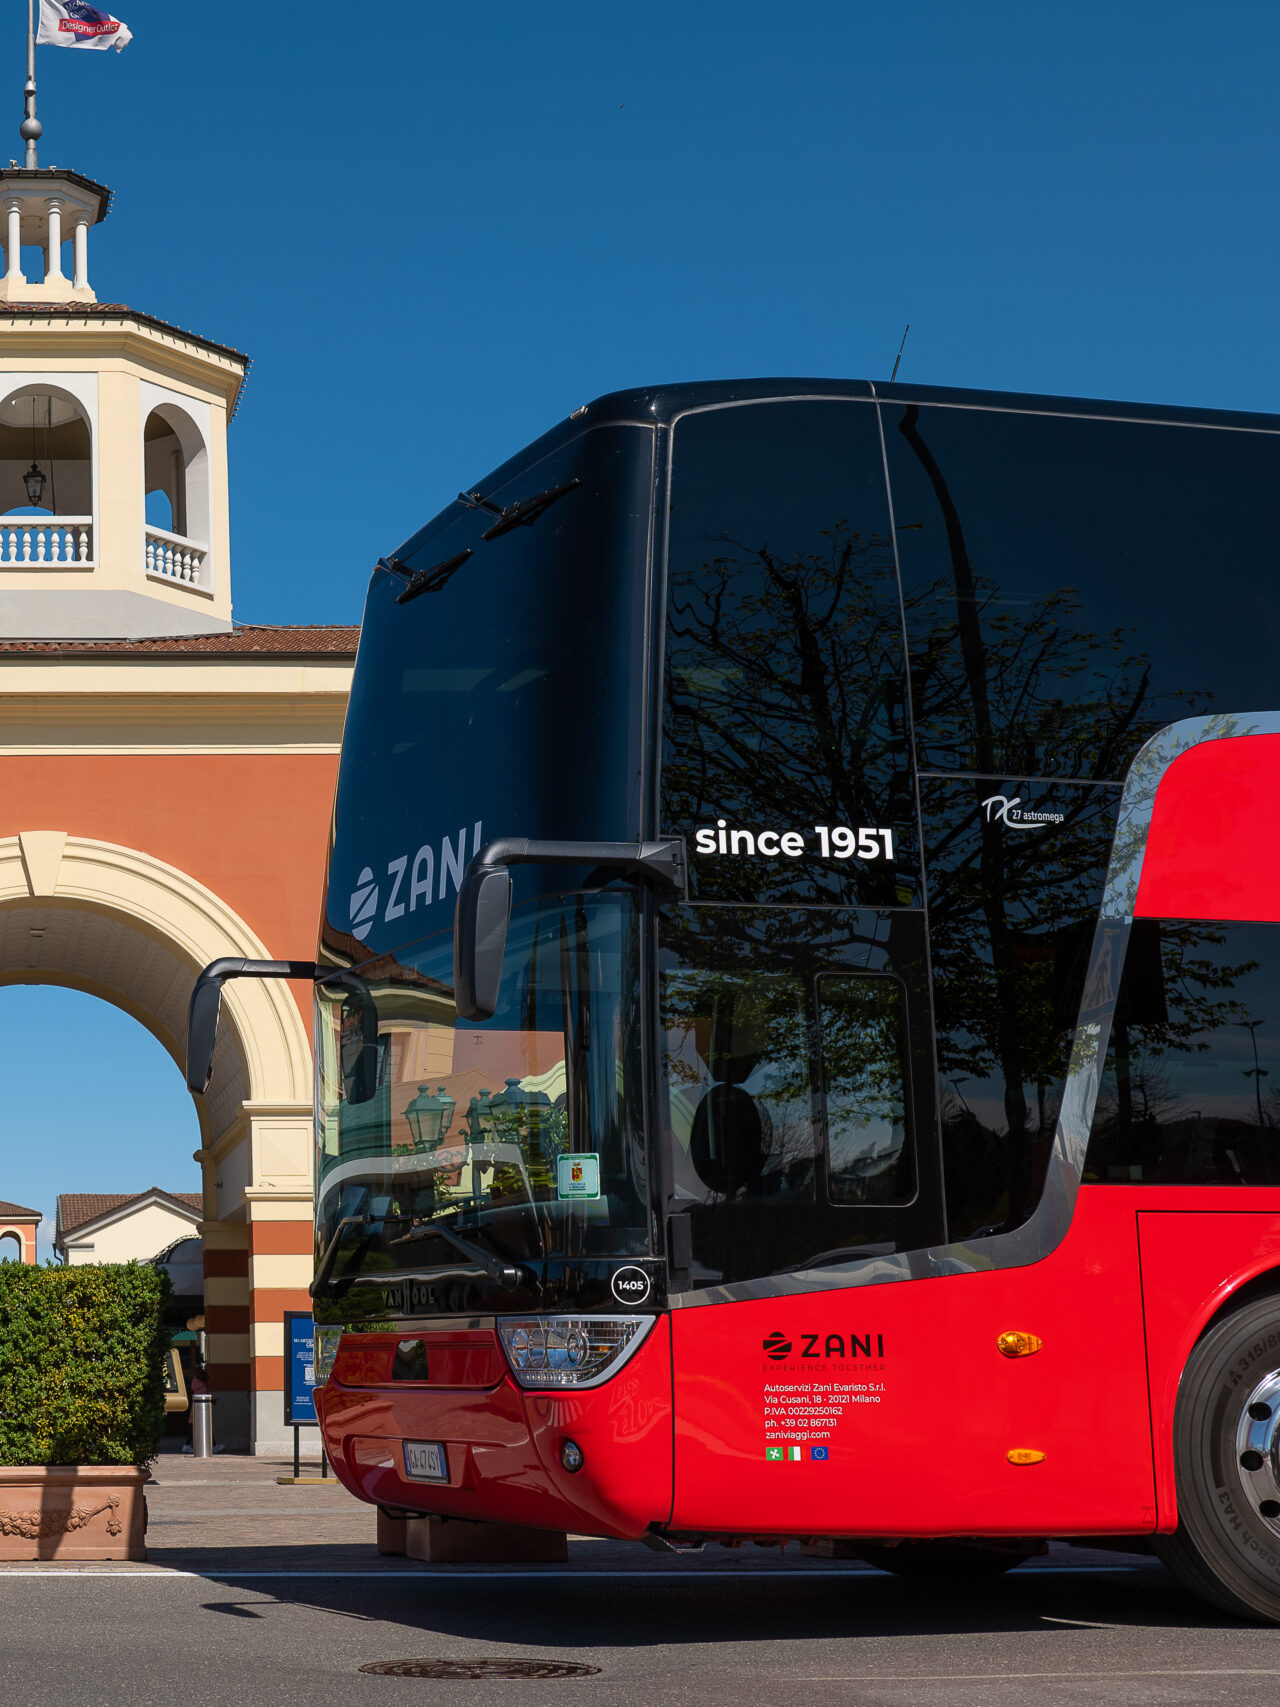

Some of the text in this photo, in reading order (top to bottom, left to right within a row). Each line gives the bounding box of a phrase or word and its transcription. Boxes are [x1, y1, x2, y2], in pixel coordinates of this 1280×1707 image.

[62, 21, 96, 34] Designer
[1012, 809, 1021, 820] 27
[1023, 811, 1065, 824] astromega
[695, 819, 894, 860] since 1951
[384, 820, 482, 923] ZANI
[617, 1280, 644, 1290] 1405
[800, 1333, 884, 1358] ZANI
[1239, 1333, 1280, 1372] 315/8
[762, 1363, 886, 1372] EXPERIENCE TOGETHER
[763, 1382, 886, 1392] Autoservizi Zani Evaristo S.r.l.
[764, 1395, 779, 1404] Via
[779, 1395, 812, 1405] Cusani,
[812, 1395, 822, 1403] 18
[828, 1394, 850, 1403] 20121
[851, 1394, 881, 1403] Milano
[764, 1406, 843, 1416] P.IVA 00229250162
[765, 1418, 837, 1429] ph. +39 02 867131
[765, 1430, 831, 1441] zaniviaggi.com
